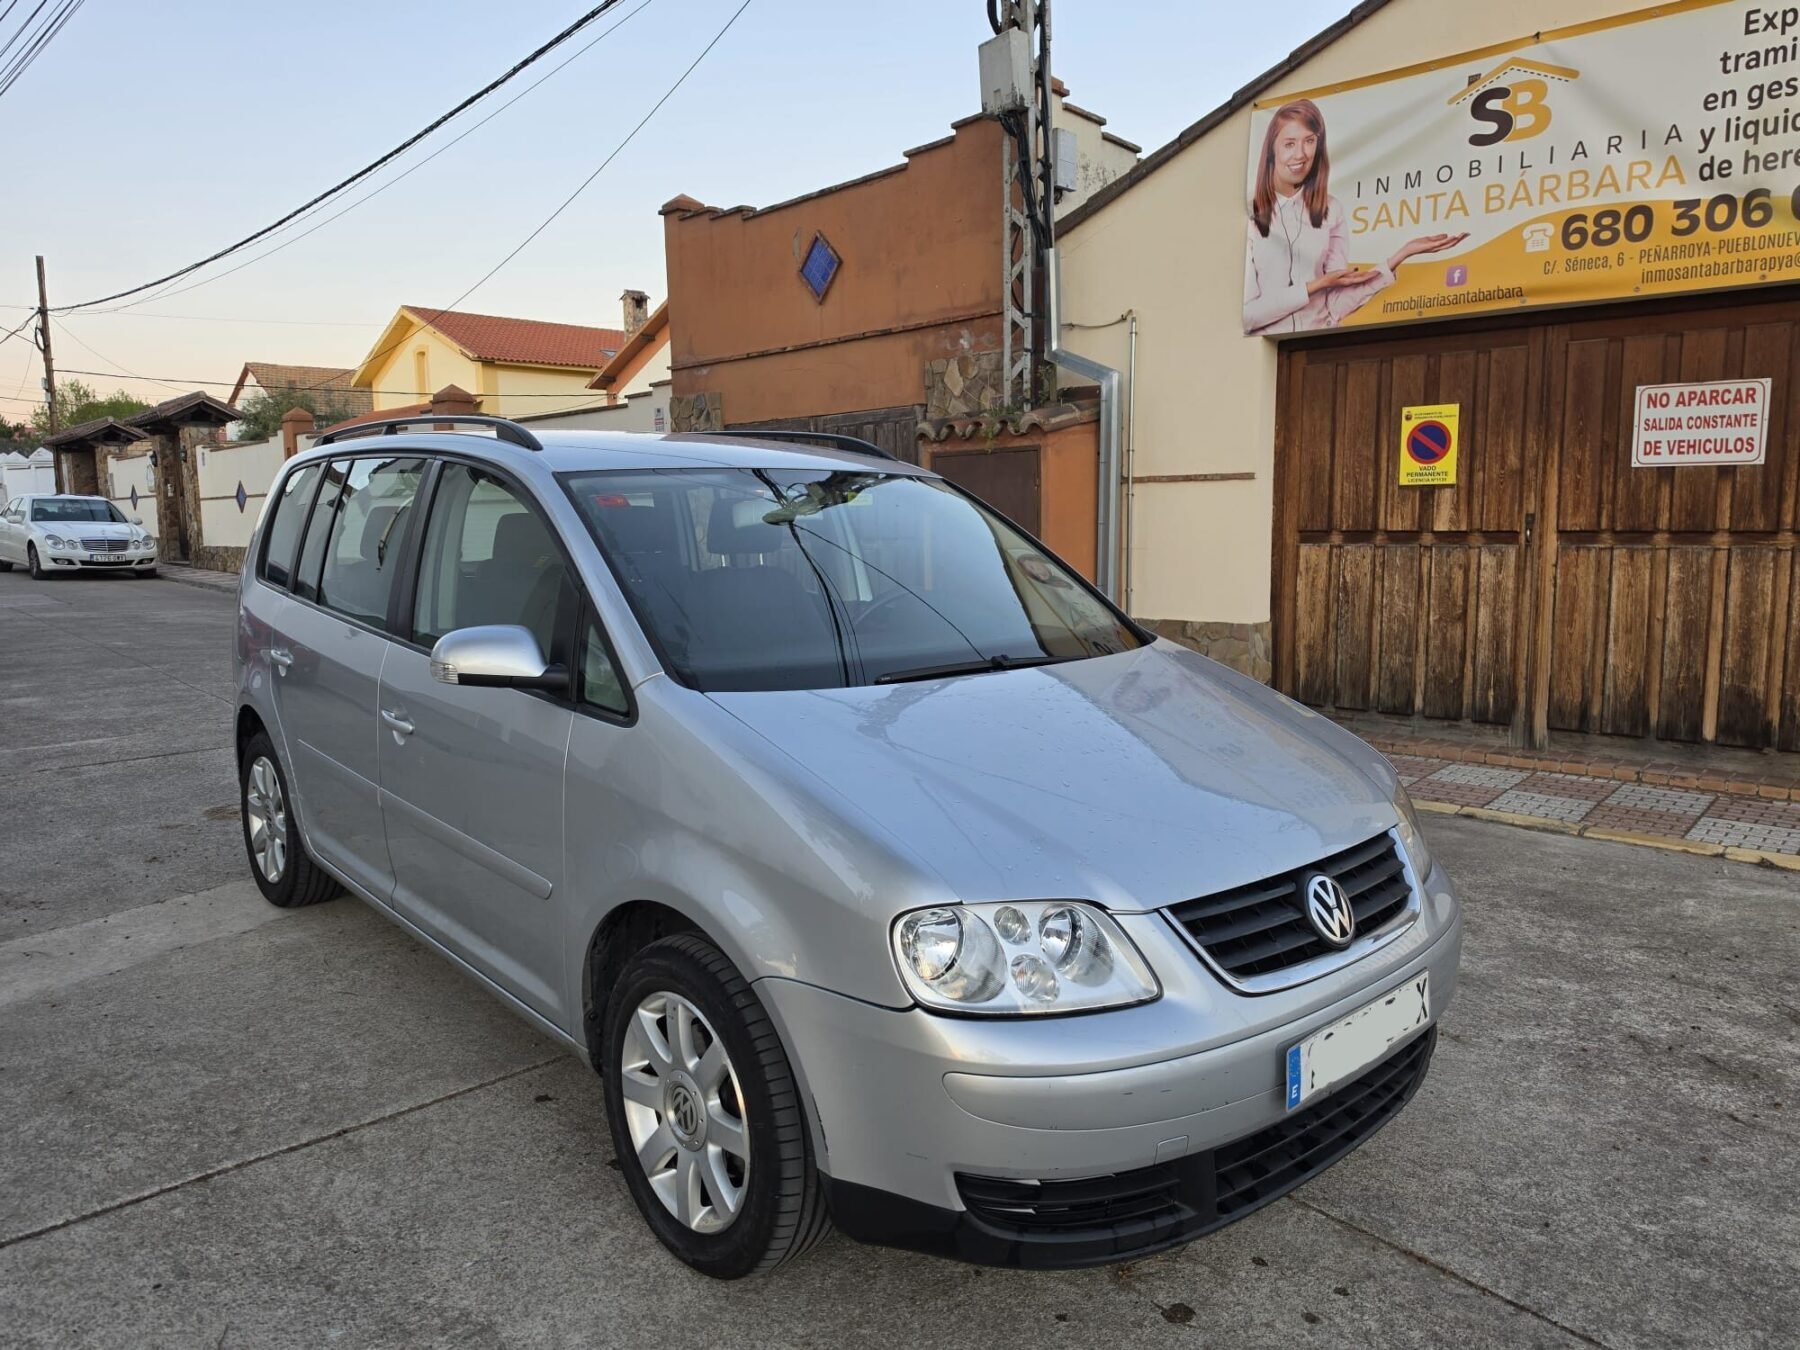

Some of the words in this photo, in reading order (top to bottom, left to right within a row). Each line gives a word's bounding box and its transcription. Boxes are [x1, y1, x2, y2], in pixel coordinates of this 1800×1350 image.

[1744, 7, 1799, 36] Exp
[1719, 36, 1799, 75] trami
[1702, 88, 1737, 112] en
[1747, 77, 1799, 111] ges
[1468, 79, 1552, 147] SB
[1697, 126, 1716, 154] y
[1356, 123, 1683, 198] INMOBILIARIA
[1698, 154, 1733, 182] de
[1351, 189, 1470, 234] SANTA
[1484, 154, 1687, 215] BÁRBARA
[1561, 204, 1655, 251] 680
[1671, 187, 1774, 237] 306
[1564, 254, 1612, 273] Séneca,
[1616, 251, 1625, 267] 6
[1382, 285, 1524, 314] inmobiliariasantabarbara
[1646, 392, 1670, 409] NO
[1675, 387, 1757, 408] APARCAR
[1643, 417, 1683, 432] SALIDA
[1686, 413, 1758, 430] CONSTANTE
[1643, 440, 1662, 456] DE
[1667, 436, 1755, 456] VEHICULOS
